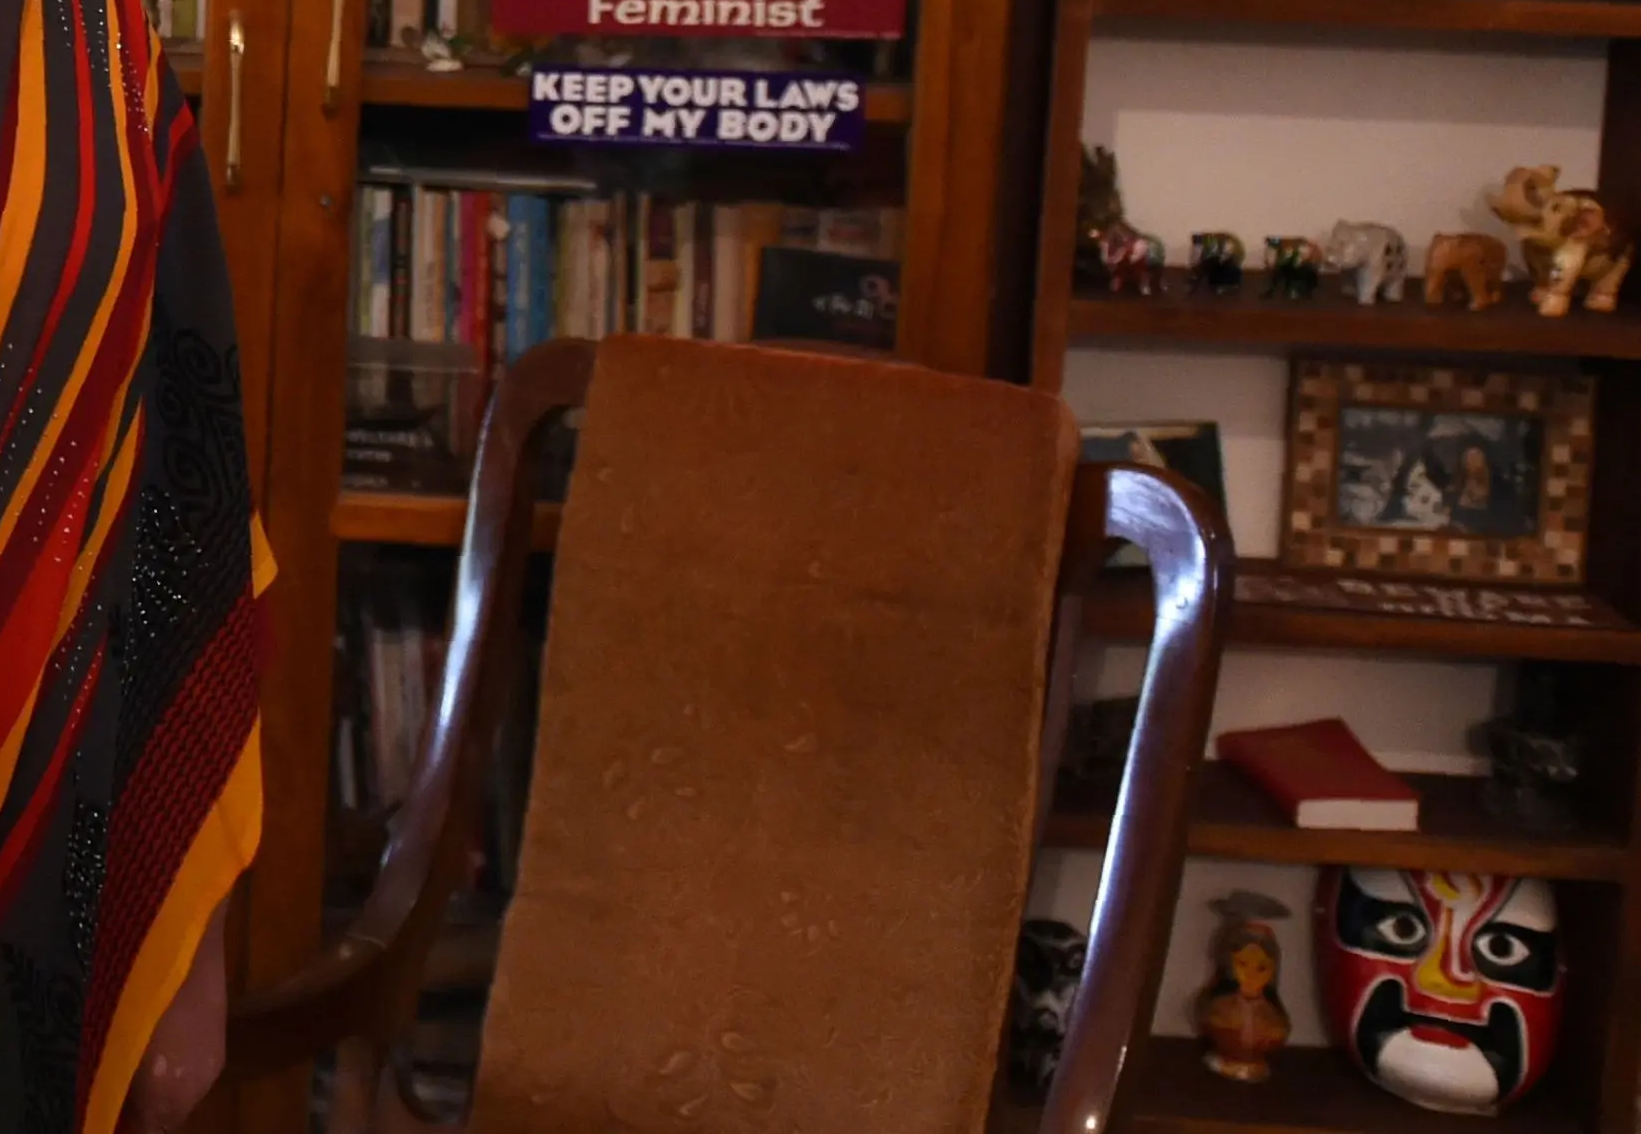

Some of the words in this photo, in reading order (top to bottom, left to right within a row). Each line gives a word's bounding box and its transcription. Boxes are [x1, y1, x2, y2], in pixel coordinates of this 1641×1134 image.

[532, 71, 635, 101] KEEP
[637, 74, 748, 107] YOUR
[754, 79, 860, 112] LAWS
[549, 103, 632, 136] OFF
[642, 107, 707, 139] MY
[716, 108, 838, 143] BODY
